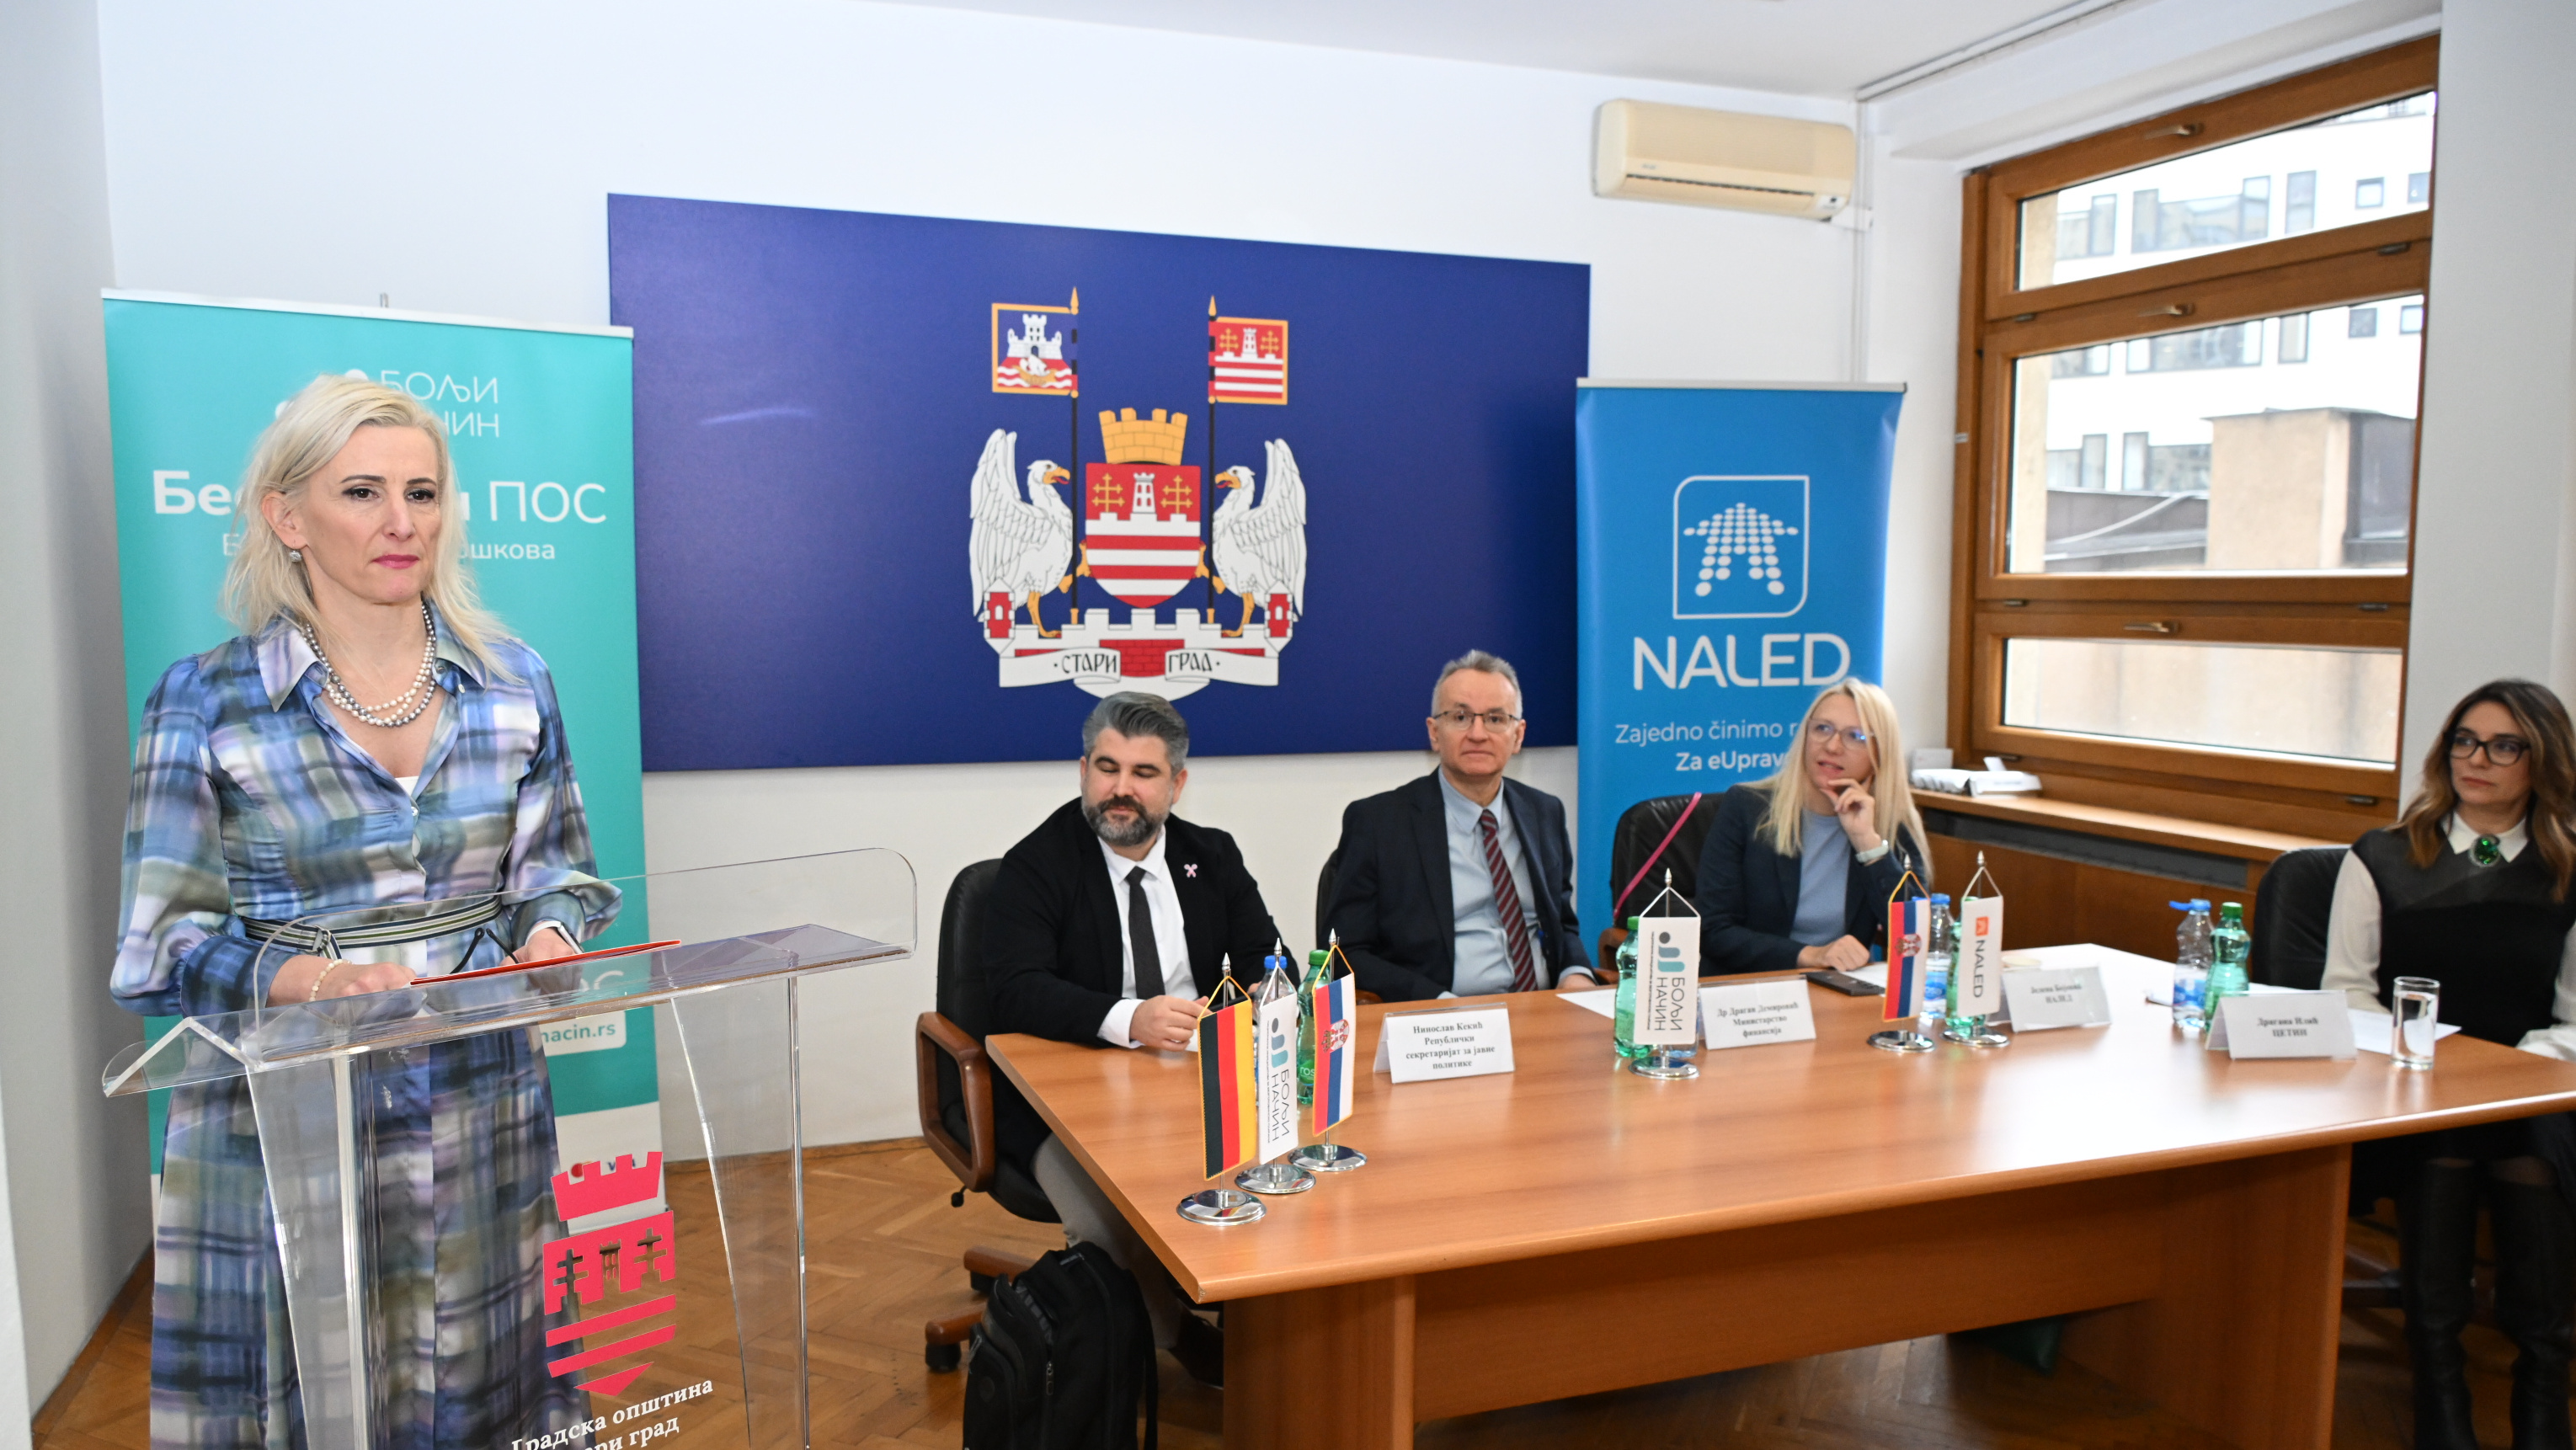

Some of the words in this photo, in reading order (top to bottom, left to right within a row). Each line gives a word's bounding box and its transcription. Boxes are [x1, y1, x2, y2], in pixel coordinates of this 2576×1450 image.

[489, 481, 606, 524] ПОС
[1062, 653, 1117, 674] СТАРИ
[1168, 652, 1213, 674] ГРАД
[1633, 632, 1851, 690] NALED
[1615, 722, 1704, 747] Zajedno
[1708, 719, 1783, 740] činimo
[1675, 752, 1703, 771] Za
[1708, 750, 1786, 773] eUprav
[1973, 939, 1986, 998] NALED
[1654, 977, 1668, 1031] НАЧИН
[541, 1023, 616, 1043] nacin.rs
[1413, 1024, 1454, 1034] Нинослав
[1457, 1021, 1483, 1031] Кекић
[1424, 1036, 1475, 1047] Републички
[1405, 1048, 1460, 1060] секретаријат
[1474, 1046, 1496, 1056] јавне
[1299, 1066, 1315, 1076] ros
[1432, 1060, 1473, 1069] политике
[613, 1379, 713, 1425] општина
